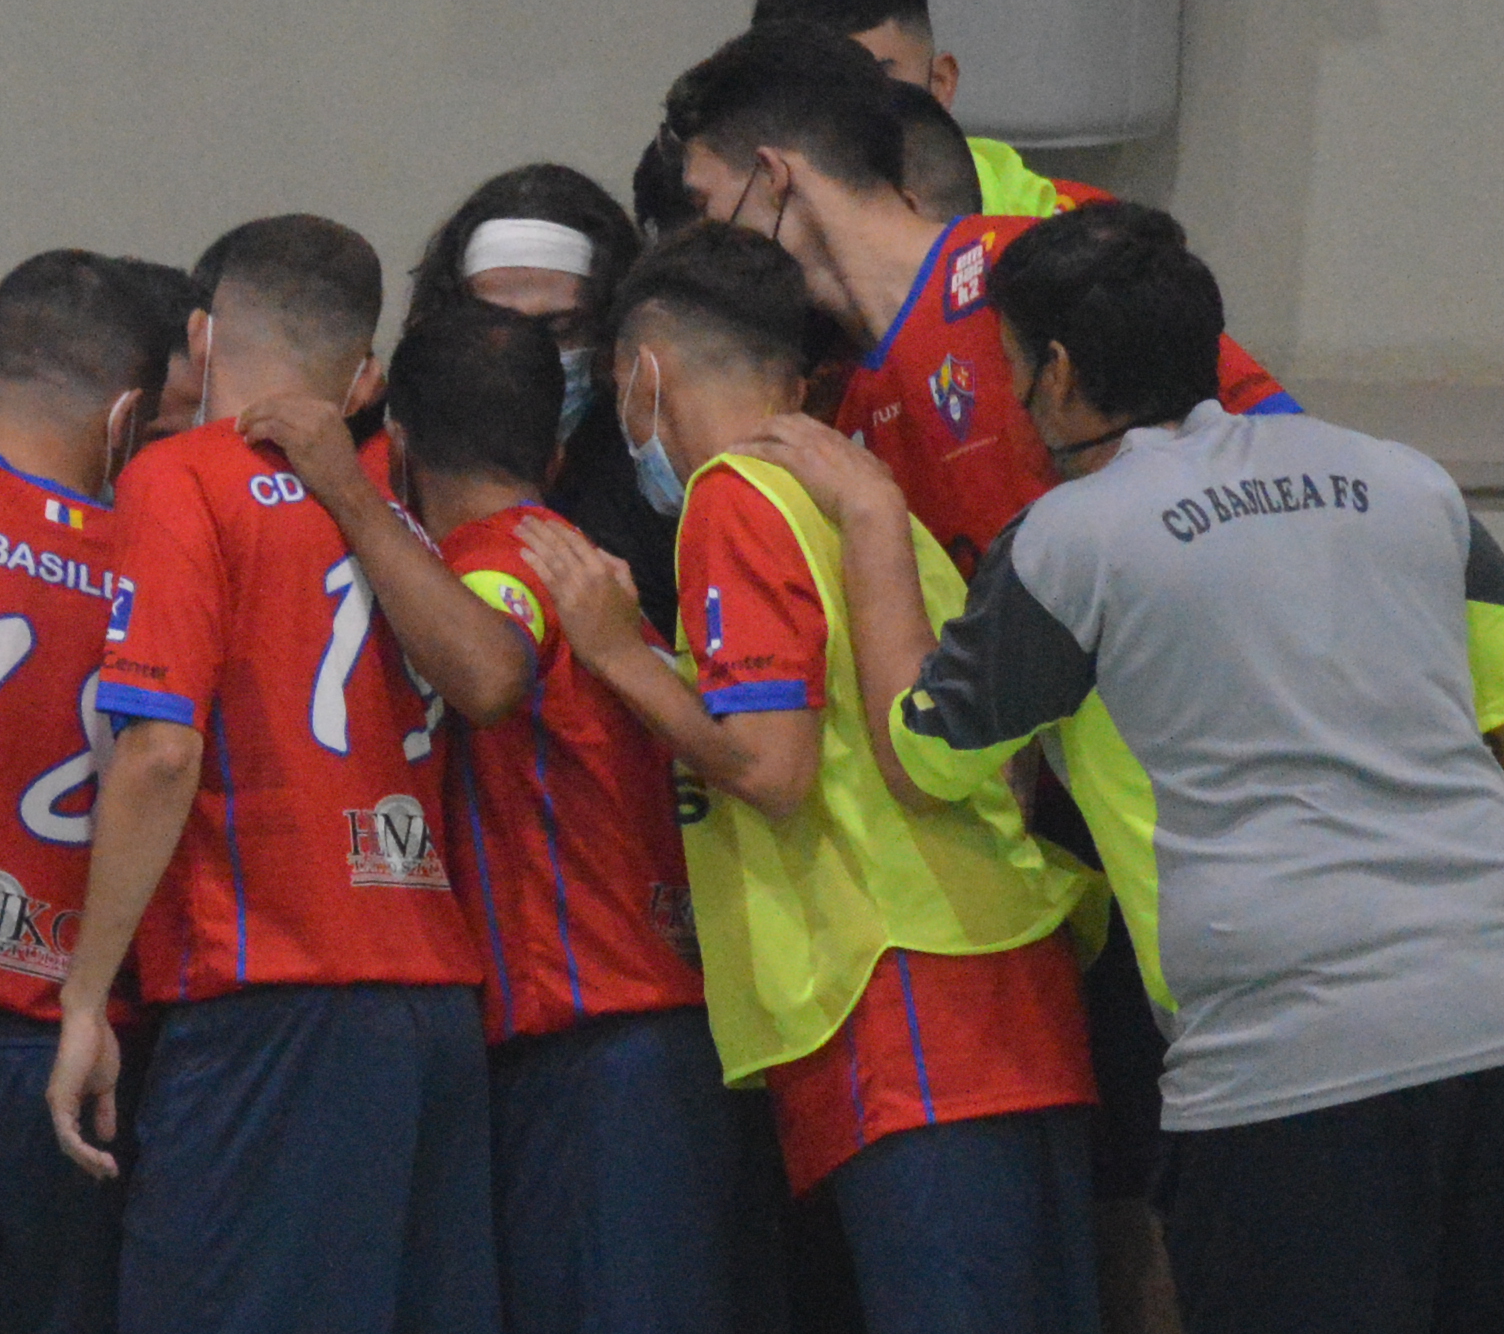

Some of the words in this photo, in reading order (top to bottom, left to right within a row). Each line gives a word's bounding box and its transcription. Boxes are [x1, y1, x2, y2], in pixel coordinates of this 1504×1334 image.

[249, 472, 306, 506] CD
[1162, 498, 1211, 542] CD
[1203, 473, 1326, 523] BASILEA
[1329, 474, 1369, 513] FS
